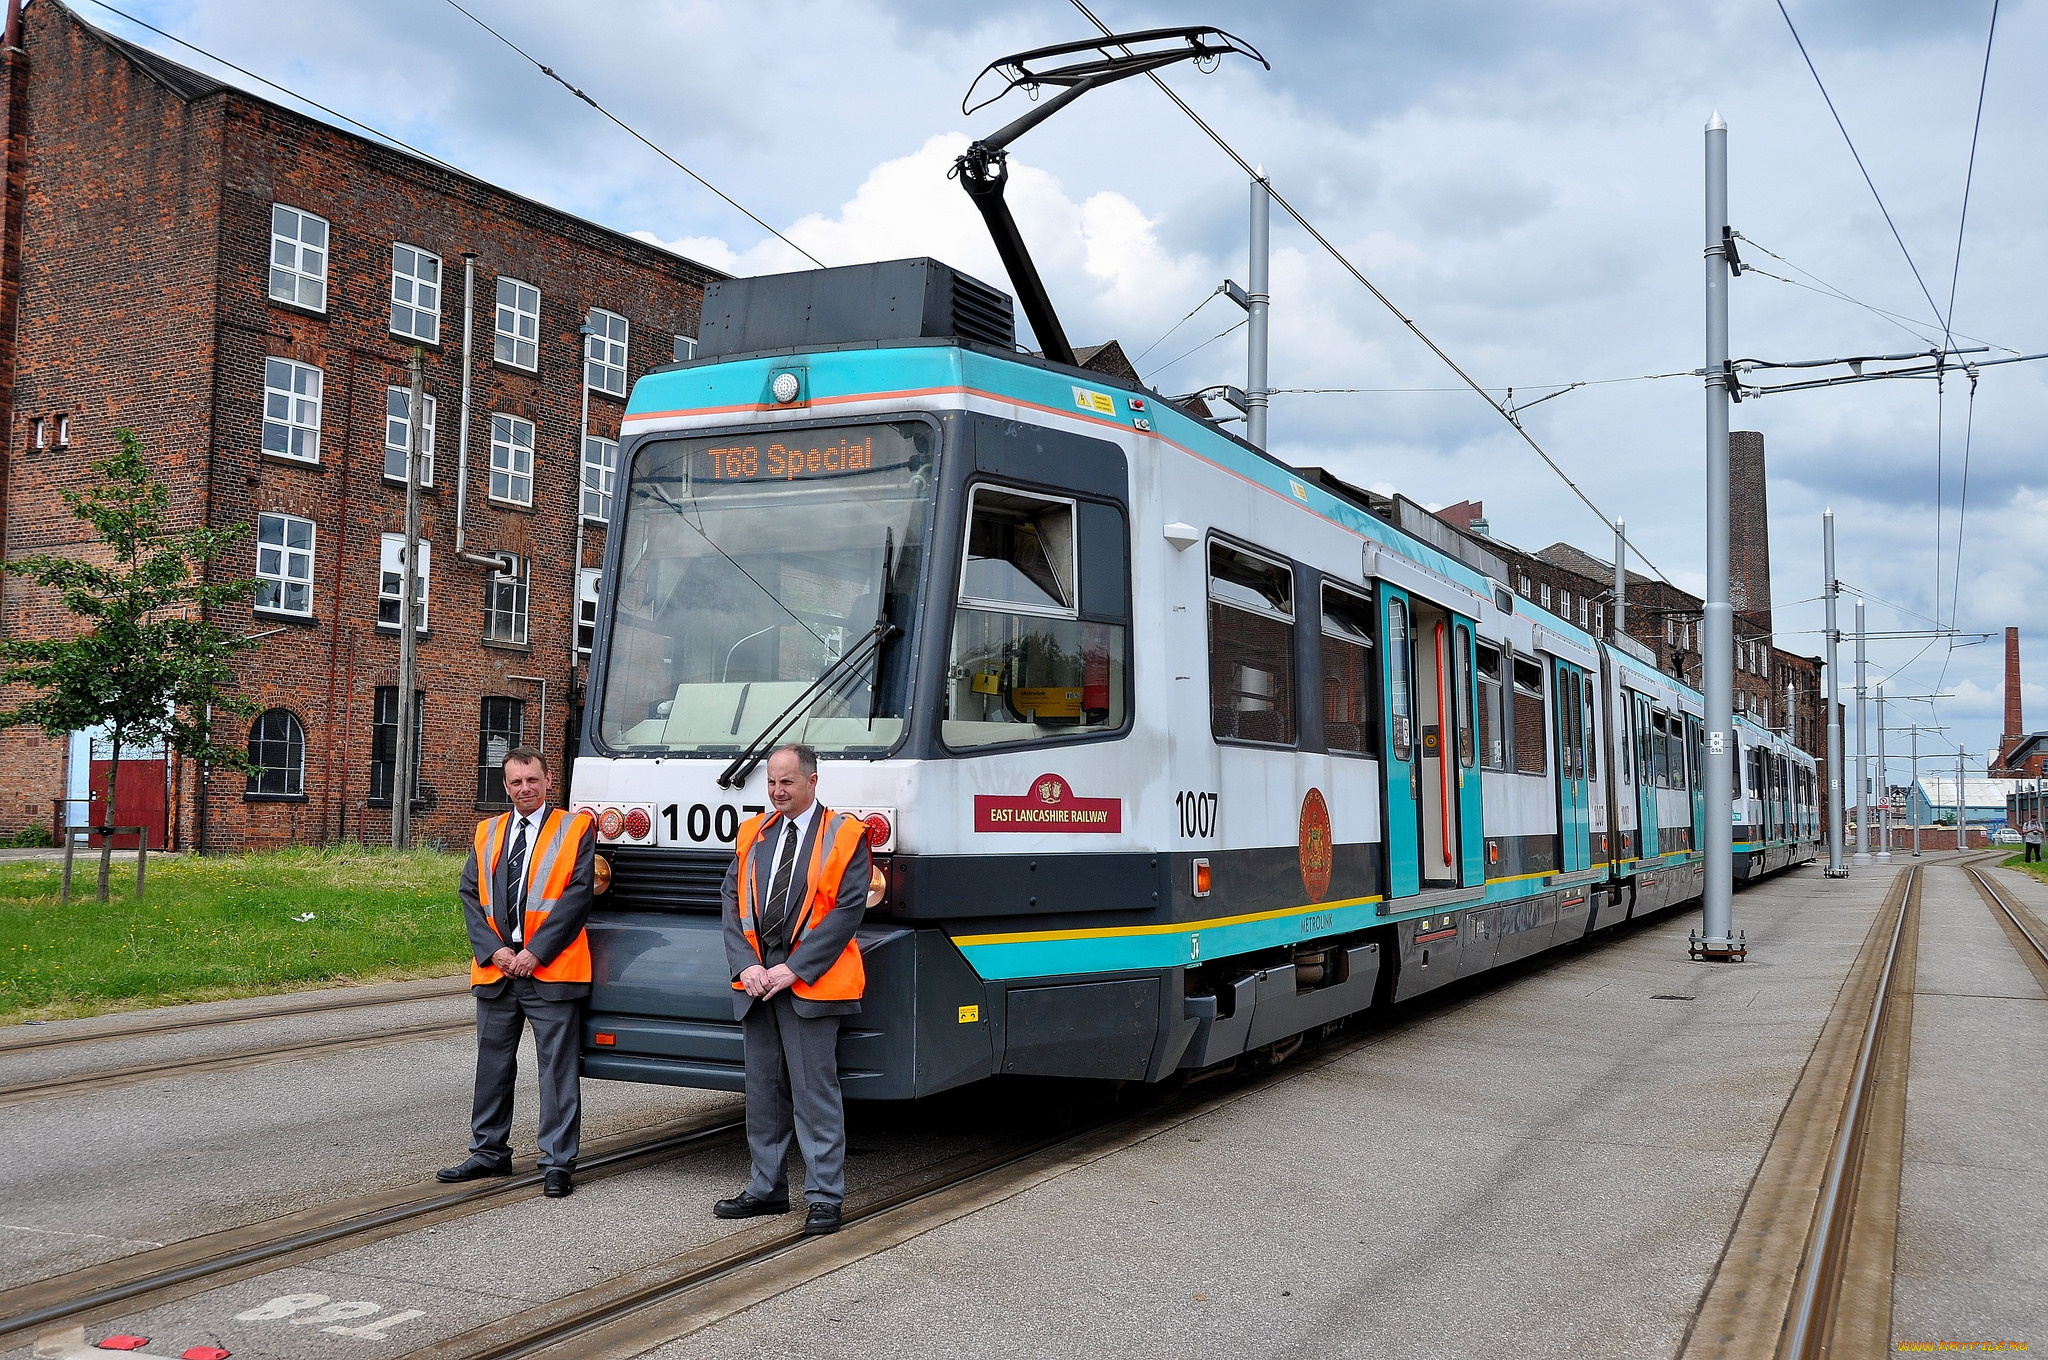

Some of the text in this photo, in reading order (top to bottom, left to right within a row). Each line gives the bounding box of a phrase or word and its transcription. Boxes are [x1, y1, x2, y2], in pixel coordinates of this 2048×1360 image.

[708, 437, 871, 481] T68 Special
[990, 809, 1108, 823] EAST LANCASHIRE RAILWAY
[1175, 790, 1218, 839] 1007
[1300, 913, 1333, 934] METROLINK
